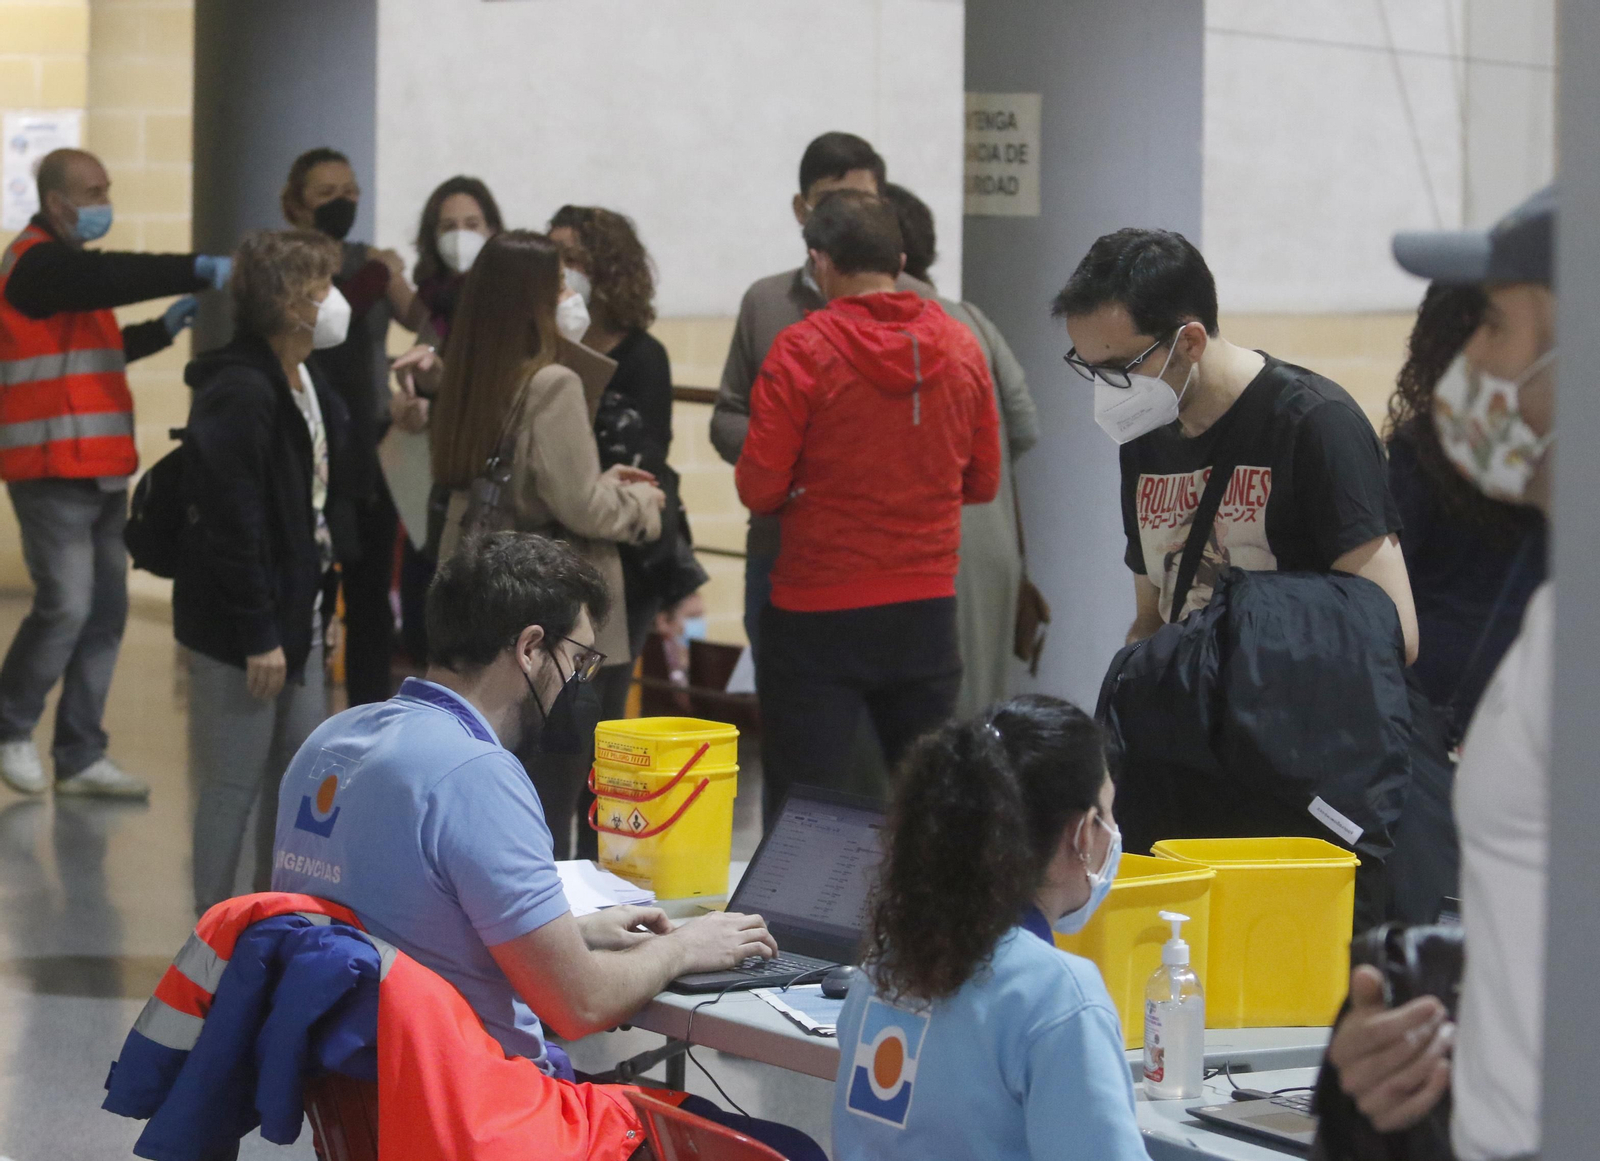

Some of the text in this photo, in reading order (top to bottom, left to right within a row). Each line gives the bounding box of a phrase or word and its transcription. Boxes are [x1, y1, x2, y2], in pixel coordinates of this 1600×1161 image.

[964, 110, 1018, 131] TENGA
[1005, 143, 1028, 164] DE
[1203, 468, 1271, 508] ONES
[275, 850, 341, 883] GENCIAS
